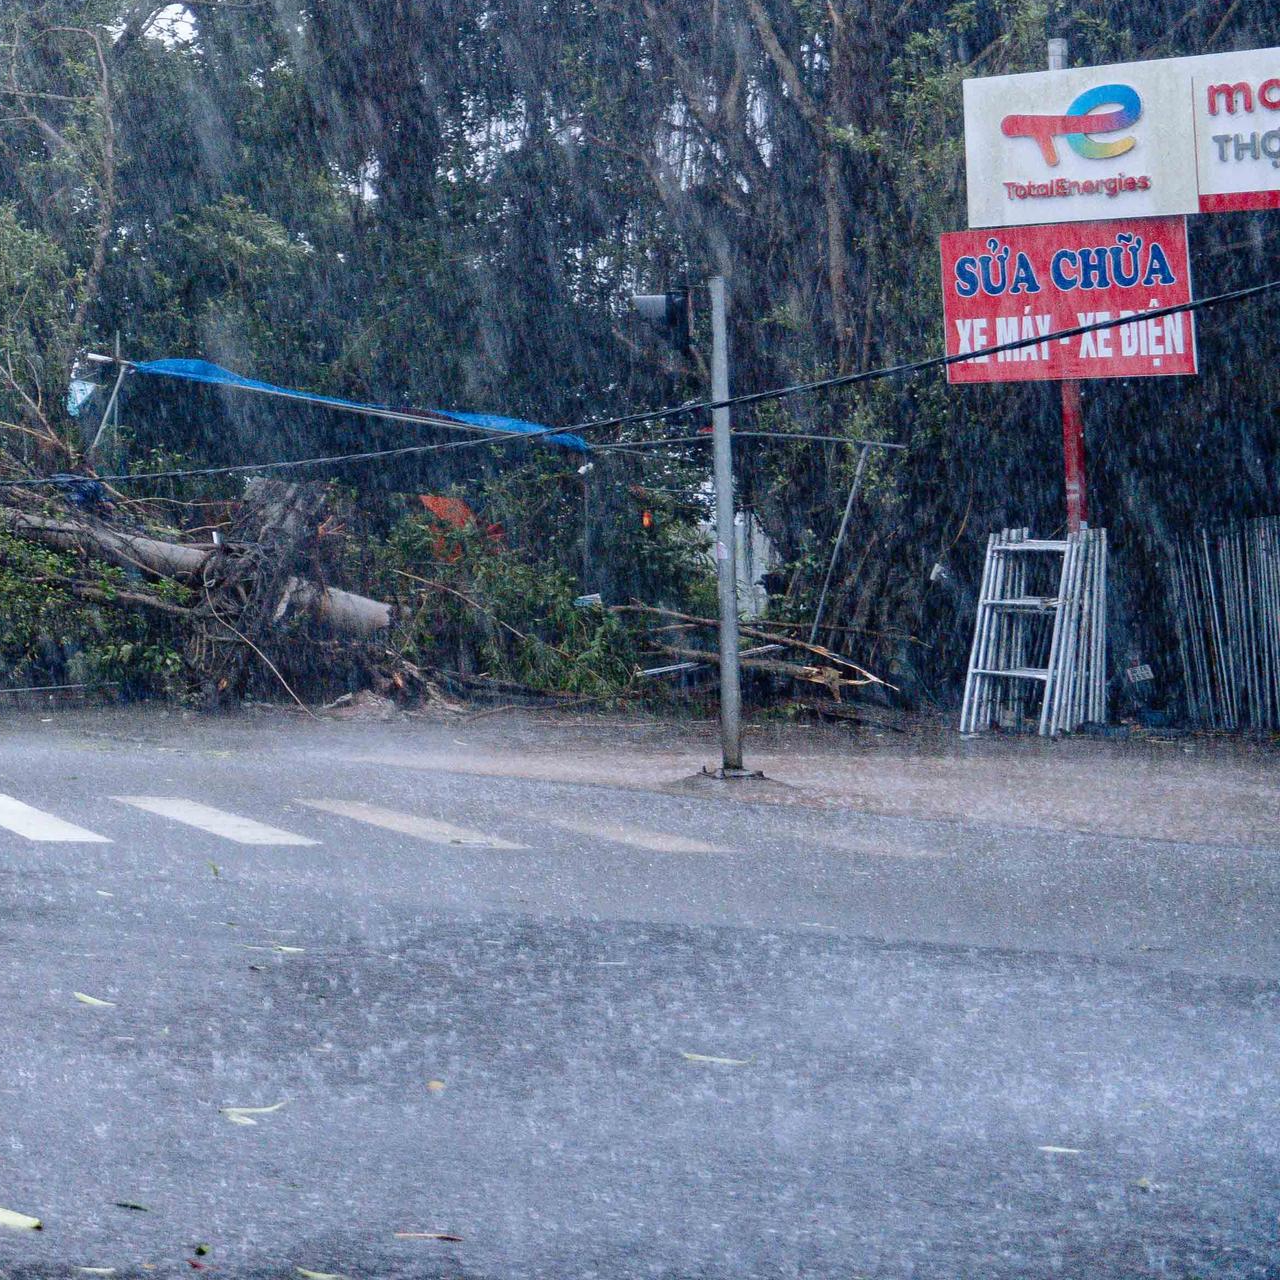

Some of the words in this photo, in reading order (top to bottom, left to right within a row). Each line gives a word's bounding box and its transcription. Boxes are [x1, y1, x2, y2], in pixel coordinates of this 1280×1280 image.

[1003, 173, 1151, 200] TotalEnergies
[955, 238, 1040, 297] SỬA
[1050, 232, 1176, 291] CHỮA
[955, 318, 989, 363] XE
[996, 306, 1050, 362] MÁY
[1077, 311, 1113, 358] XE
[1120, 298, 1184, 366] ĐIỆN
